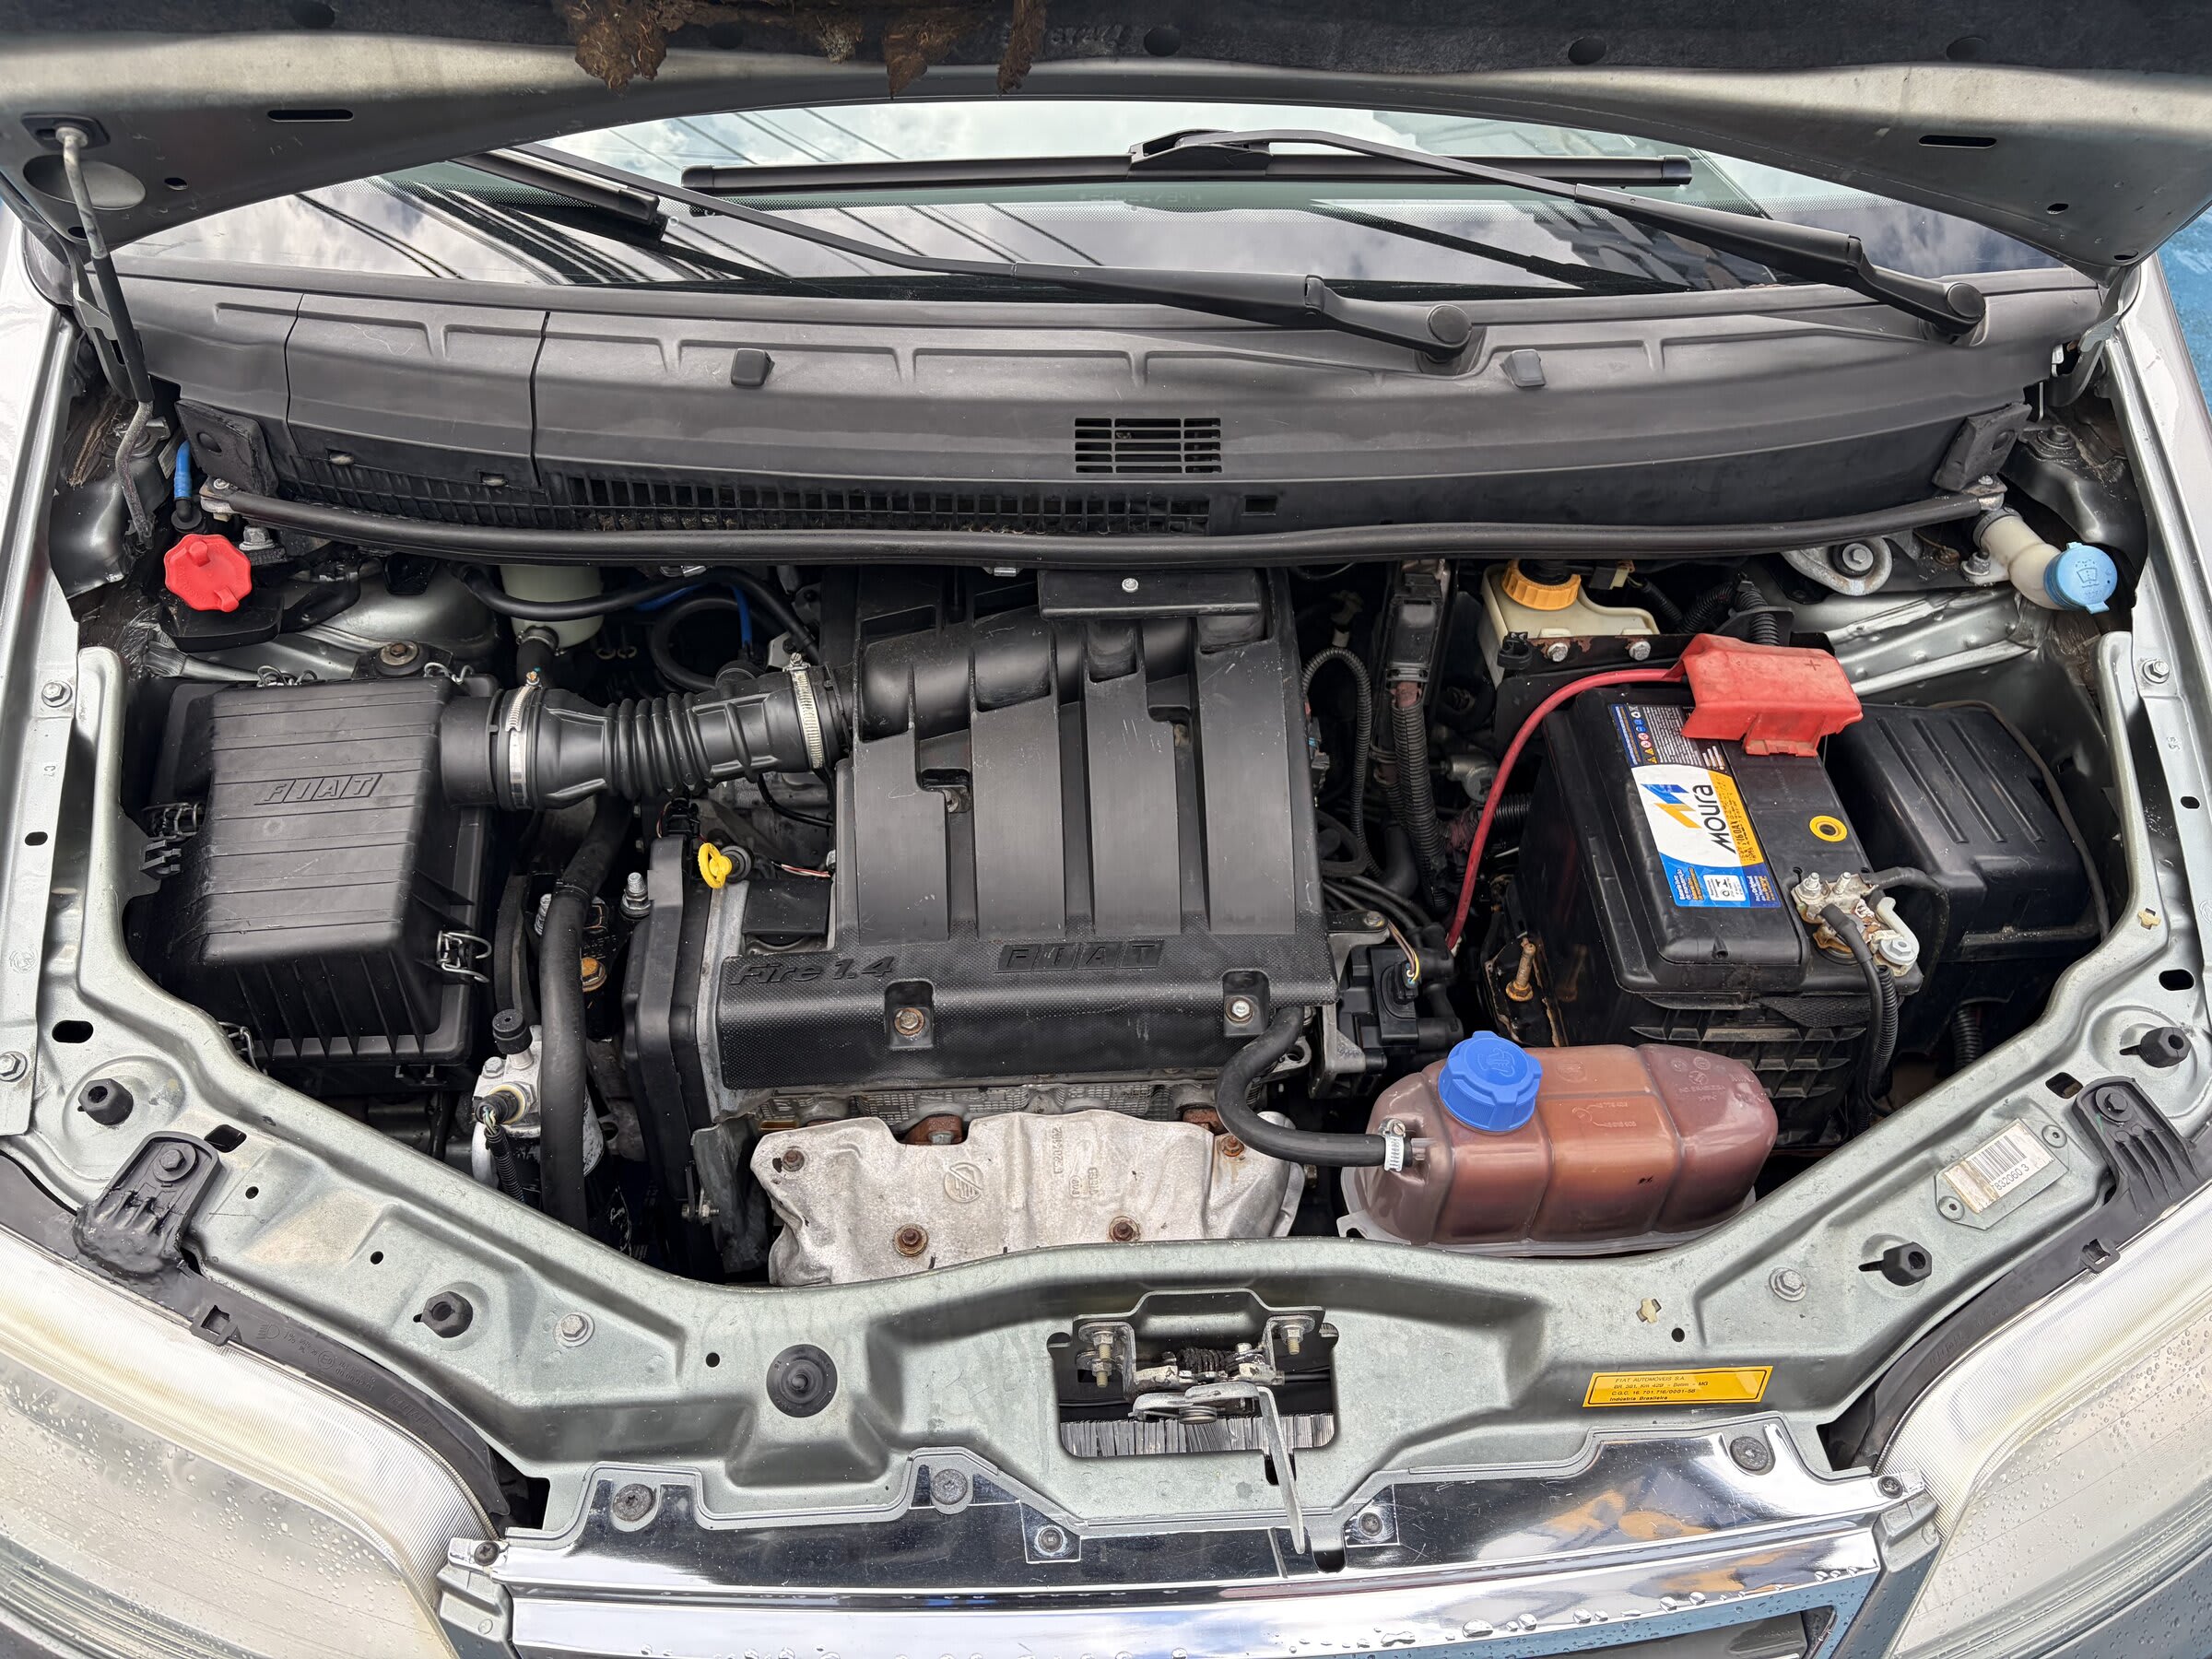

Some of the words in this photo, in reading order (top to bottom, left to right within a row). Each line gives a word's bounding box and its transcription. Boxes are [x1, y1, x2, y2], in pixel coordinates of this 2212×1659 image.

[262, 775, 376, 802] FIAT
[1001, 943, 1159, 967] FIAT
[730, 963, 822, 986] Fire
[831, 956, 895, 981] 1.4
